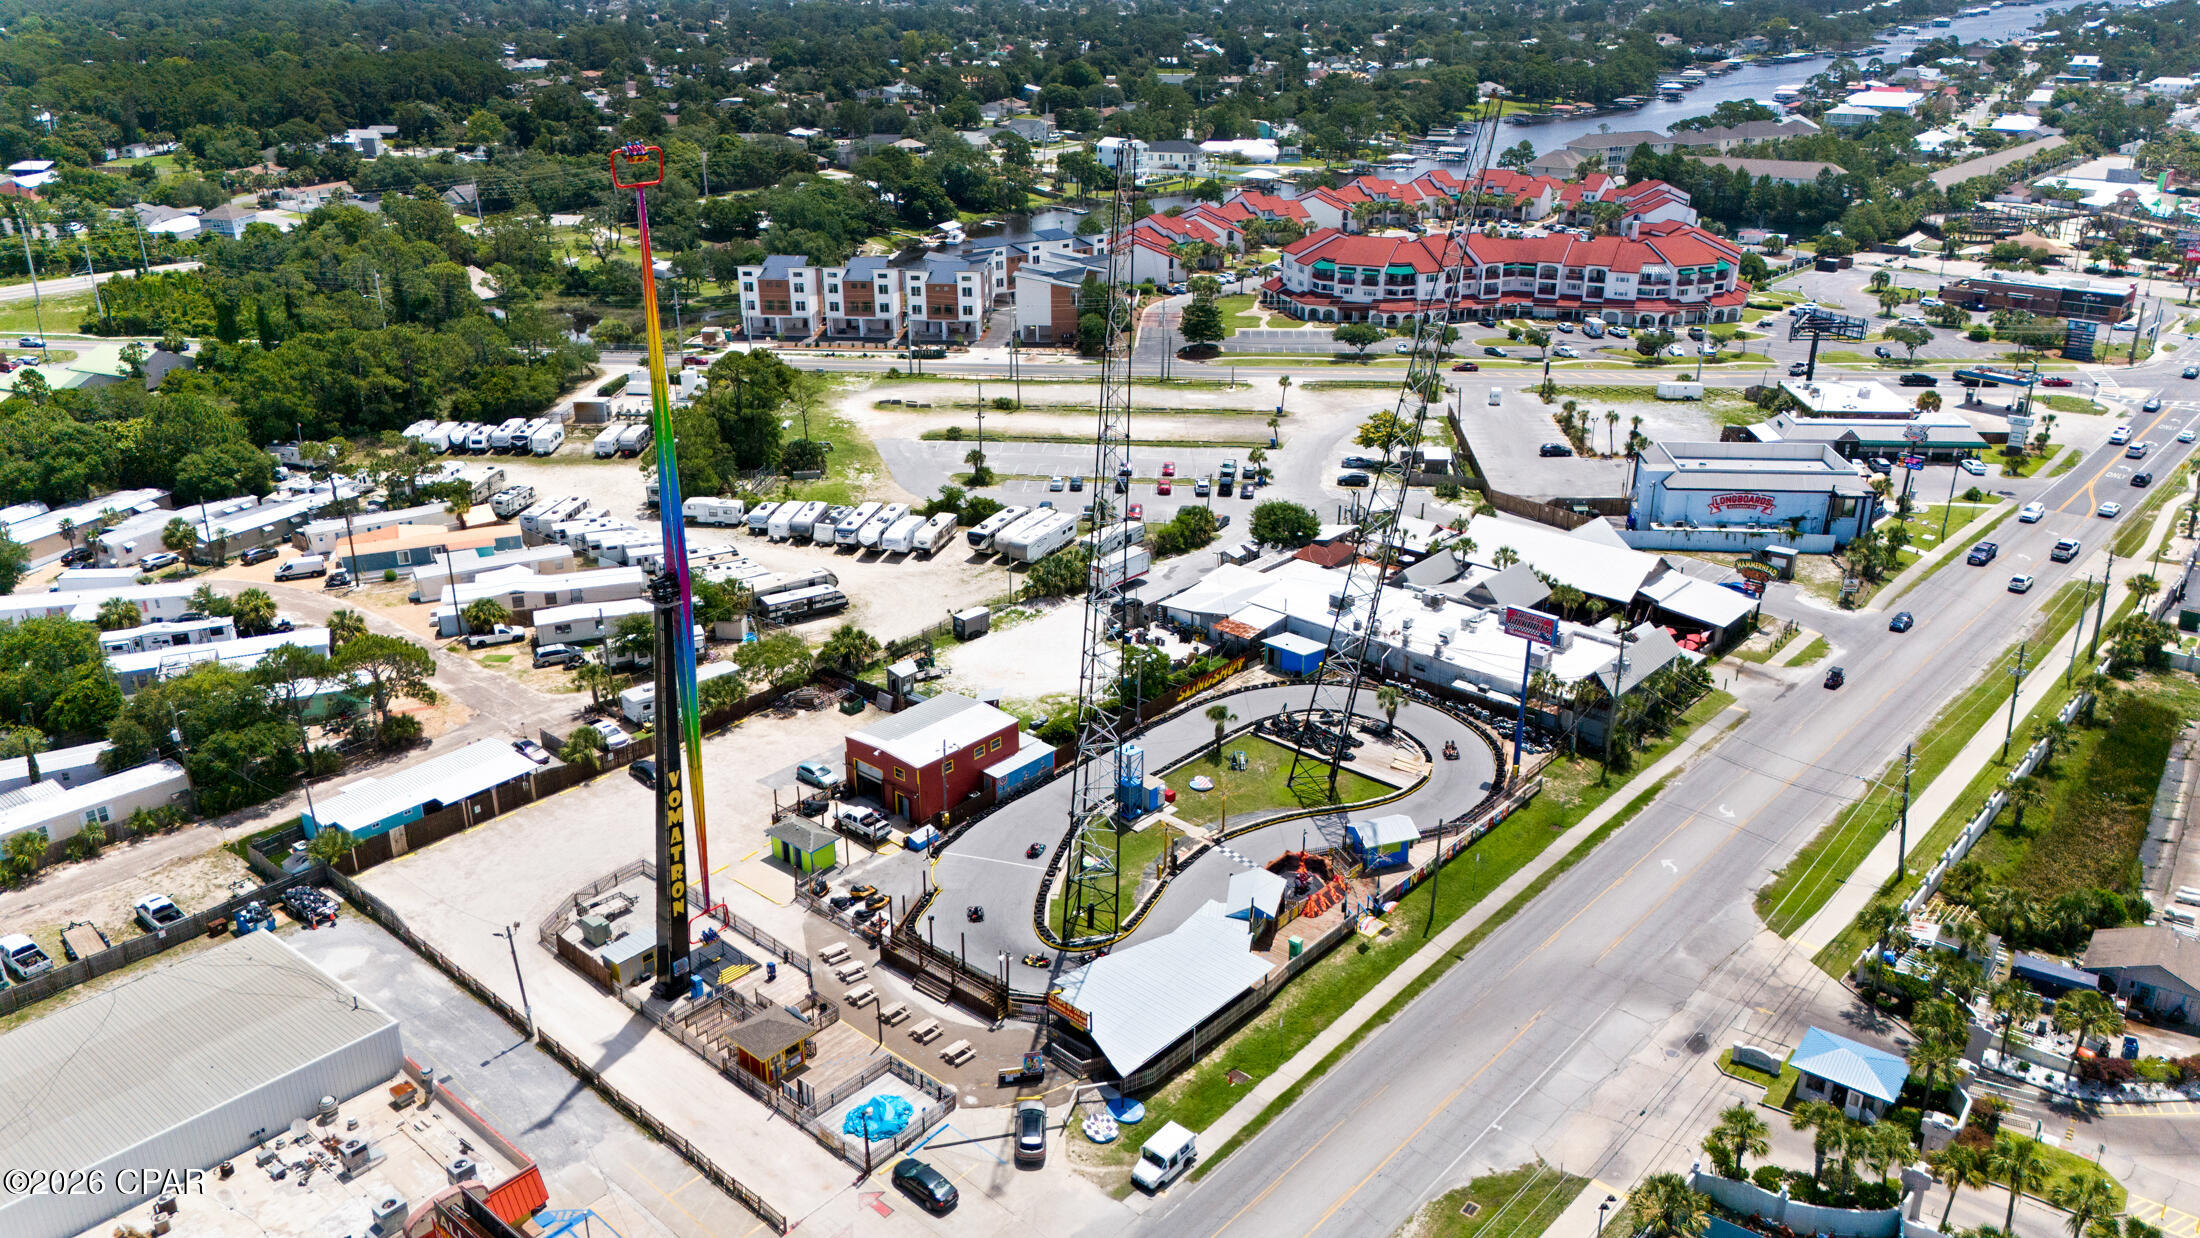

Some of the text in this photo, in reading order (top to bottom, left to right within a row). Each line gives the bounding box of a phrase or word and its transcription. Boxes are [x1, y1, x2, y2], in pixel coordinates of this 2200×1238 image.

[2105, 472, 2127, 480] ONLY
[1713, 495, 1773, 507] LONGBOARDS
[1736, 560, 1778, 577] HAMMERHEAD
[668, 769, 685, 917] VOMATRON
[1395, 857, 1440, 898] PANAM
